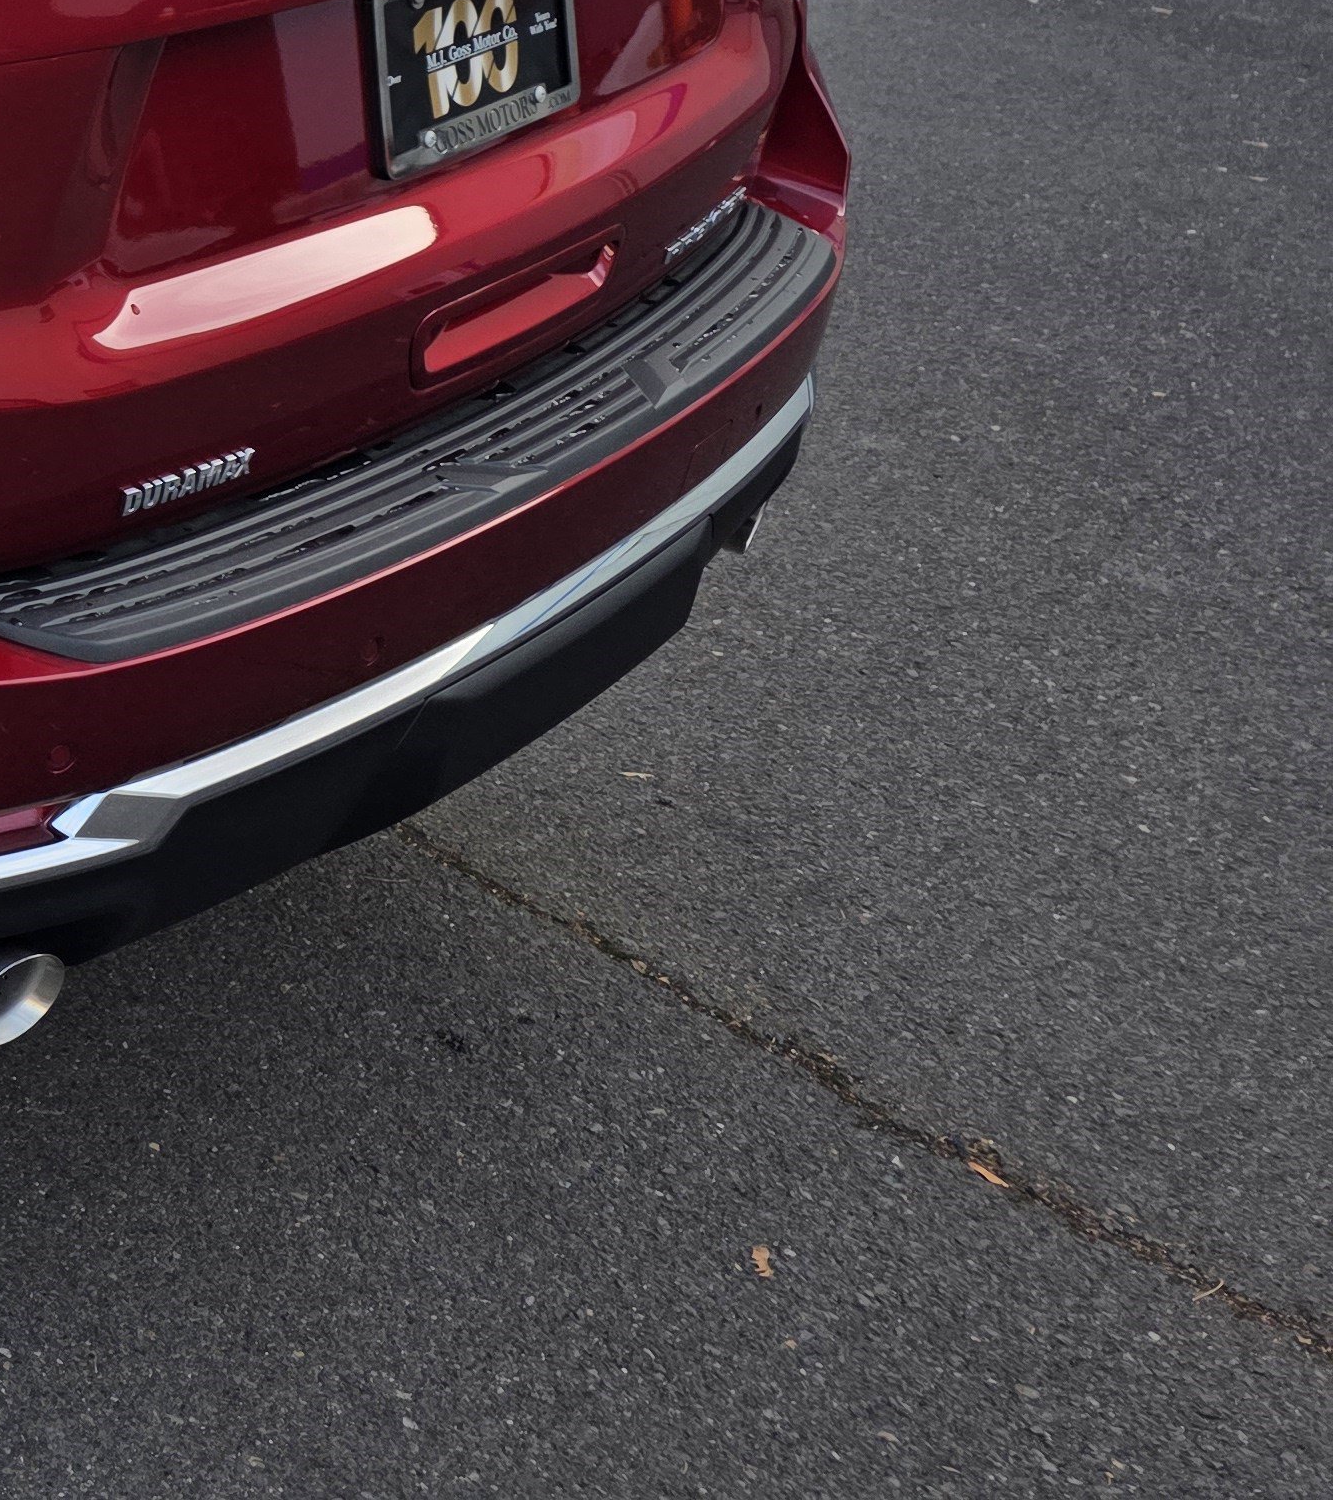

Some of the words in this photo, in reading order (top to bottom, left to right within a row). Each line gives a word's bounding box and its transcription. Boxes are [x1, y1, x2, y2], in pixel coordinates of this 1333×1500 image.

[448, 42, 472, 61] Goss
[472, 30, 502, 55] Motor
[119, 446, 256, 517] DURAMAX
